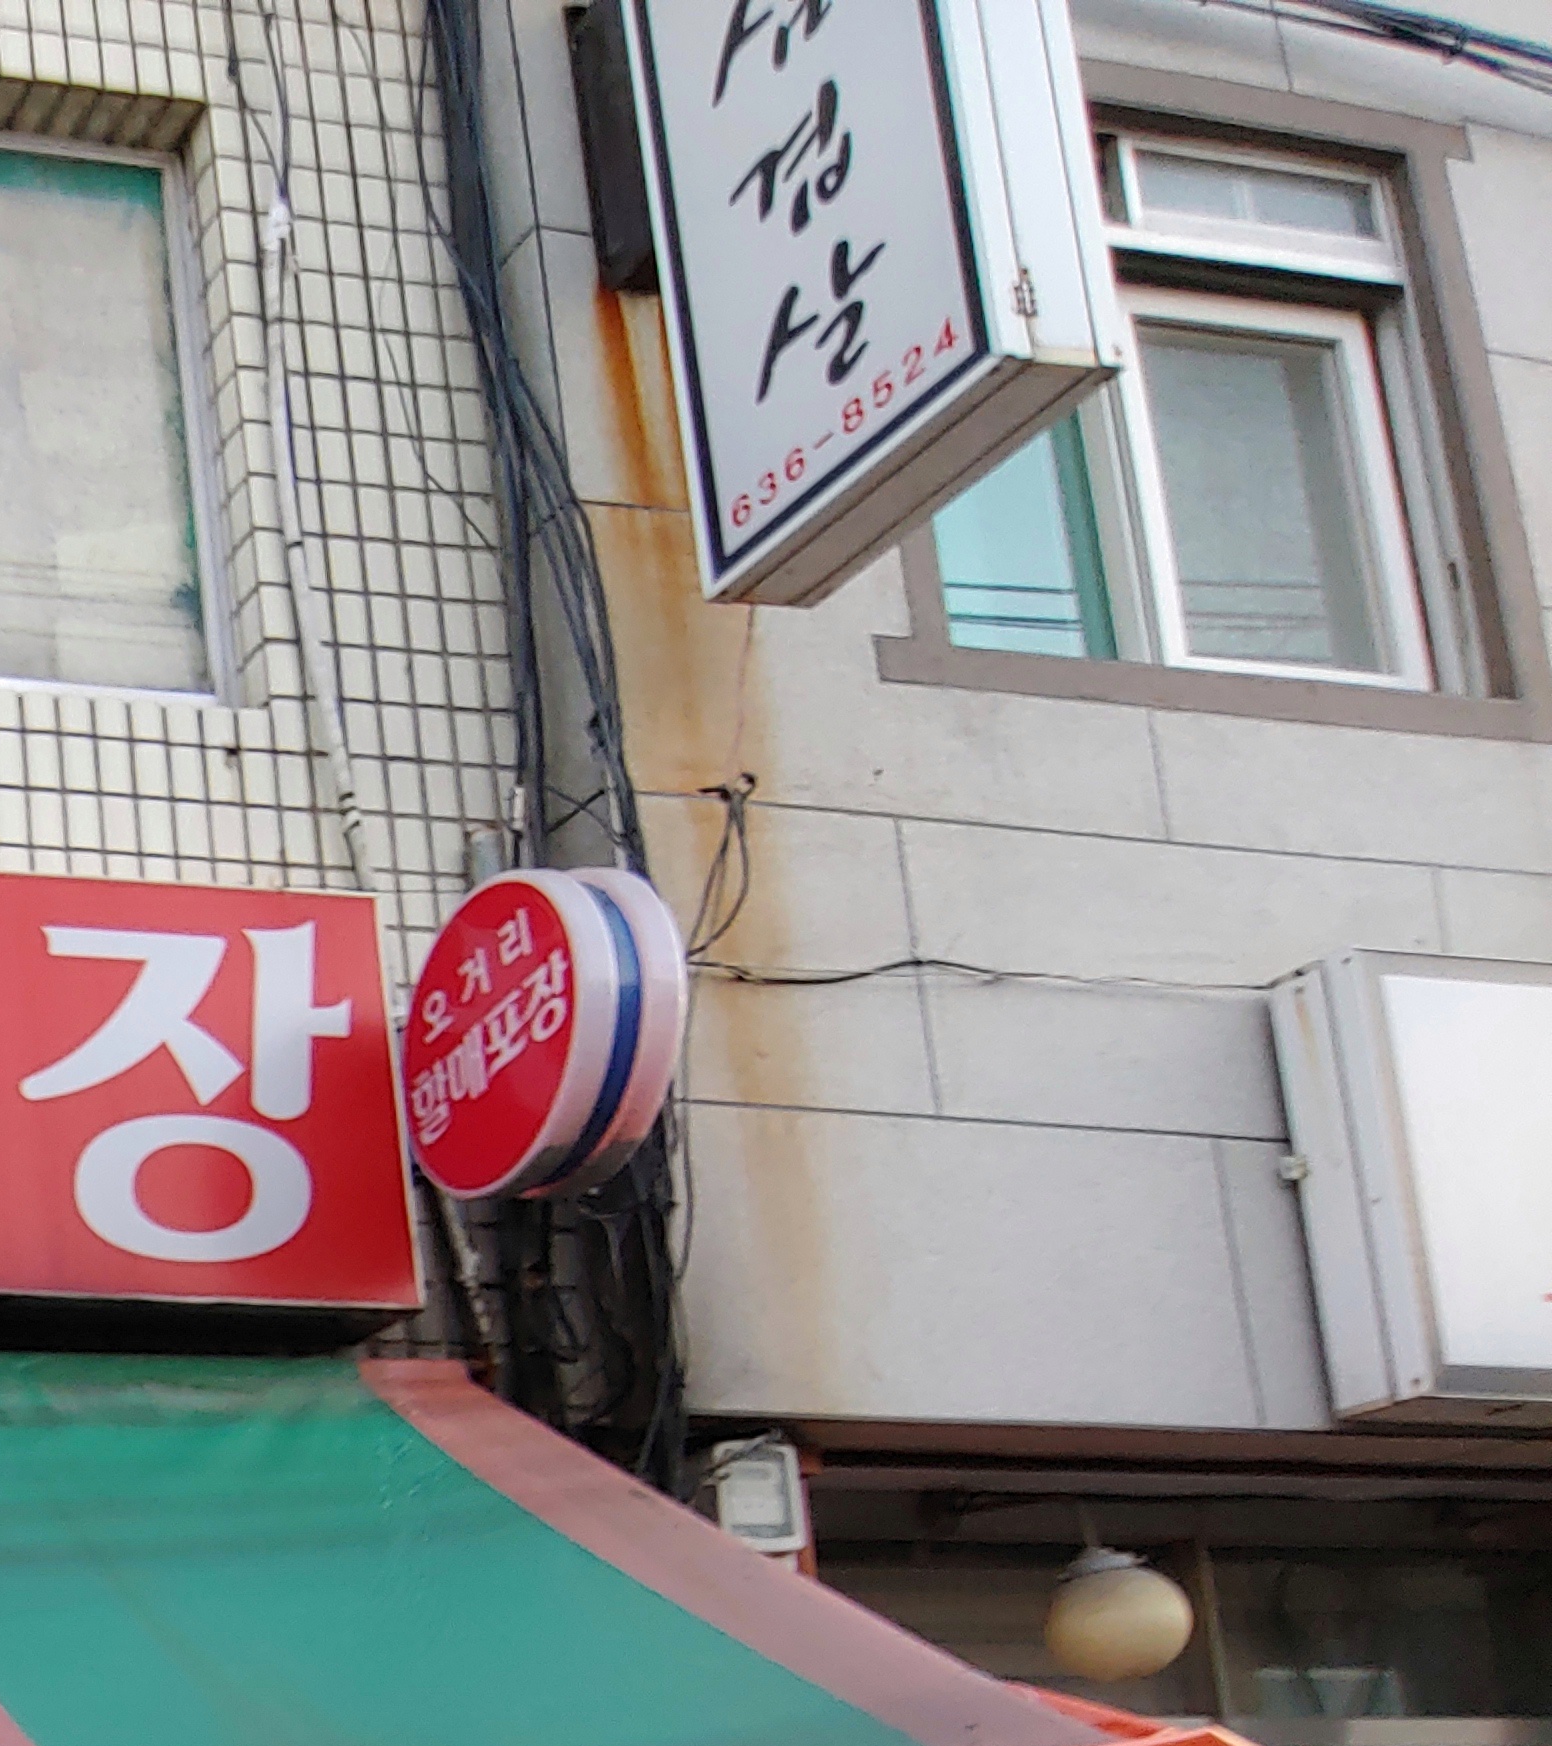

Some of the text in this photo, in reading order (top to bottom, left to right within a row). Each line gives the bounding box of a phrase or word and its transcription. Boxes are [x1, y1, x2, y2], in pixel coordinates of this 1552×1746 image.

[731, 316, 961, 528] 636-8524
[410, 948, 570, 1147] 할매포장
[421, 906, 535, 1044] 오거리
